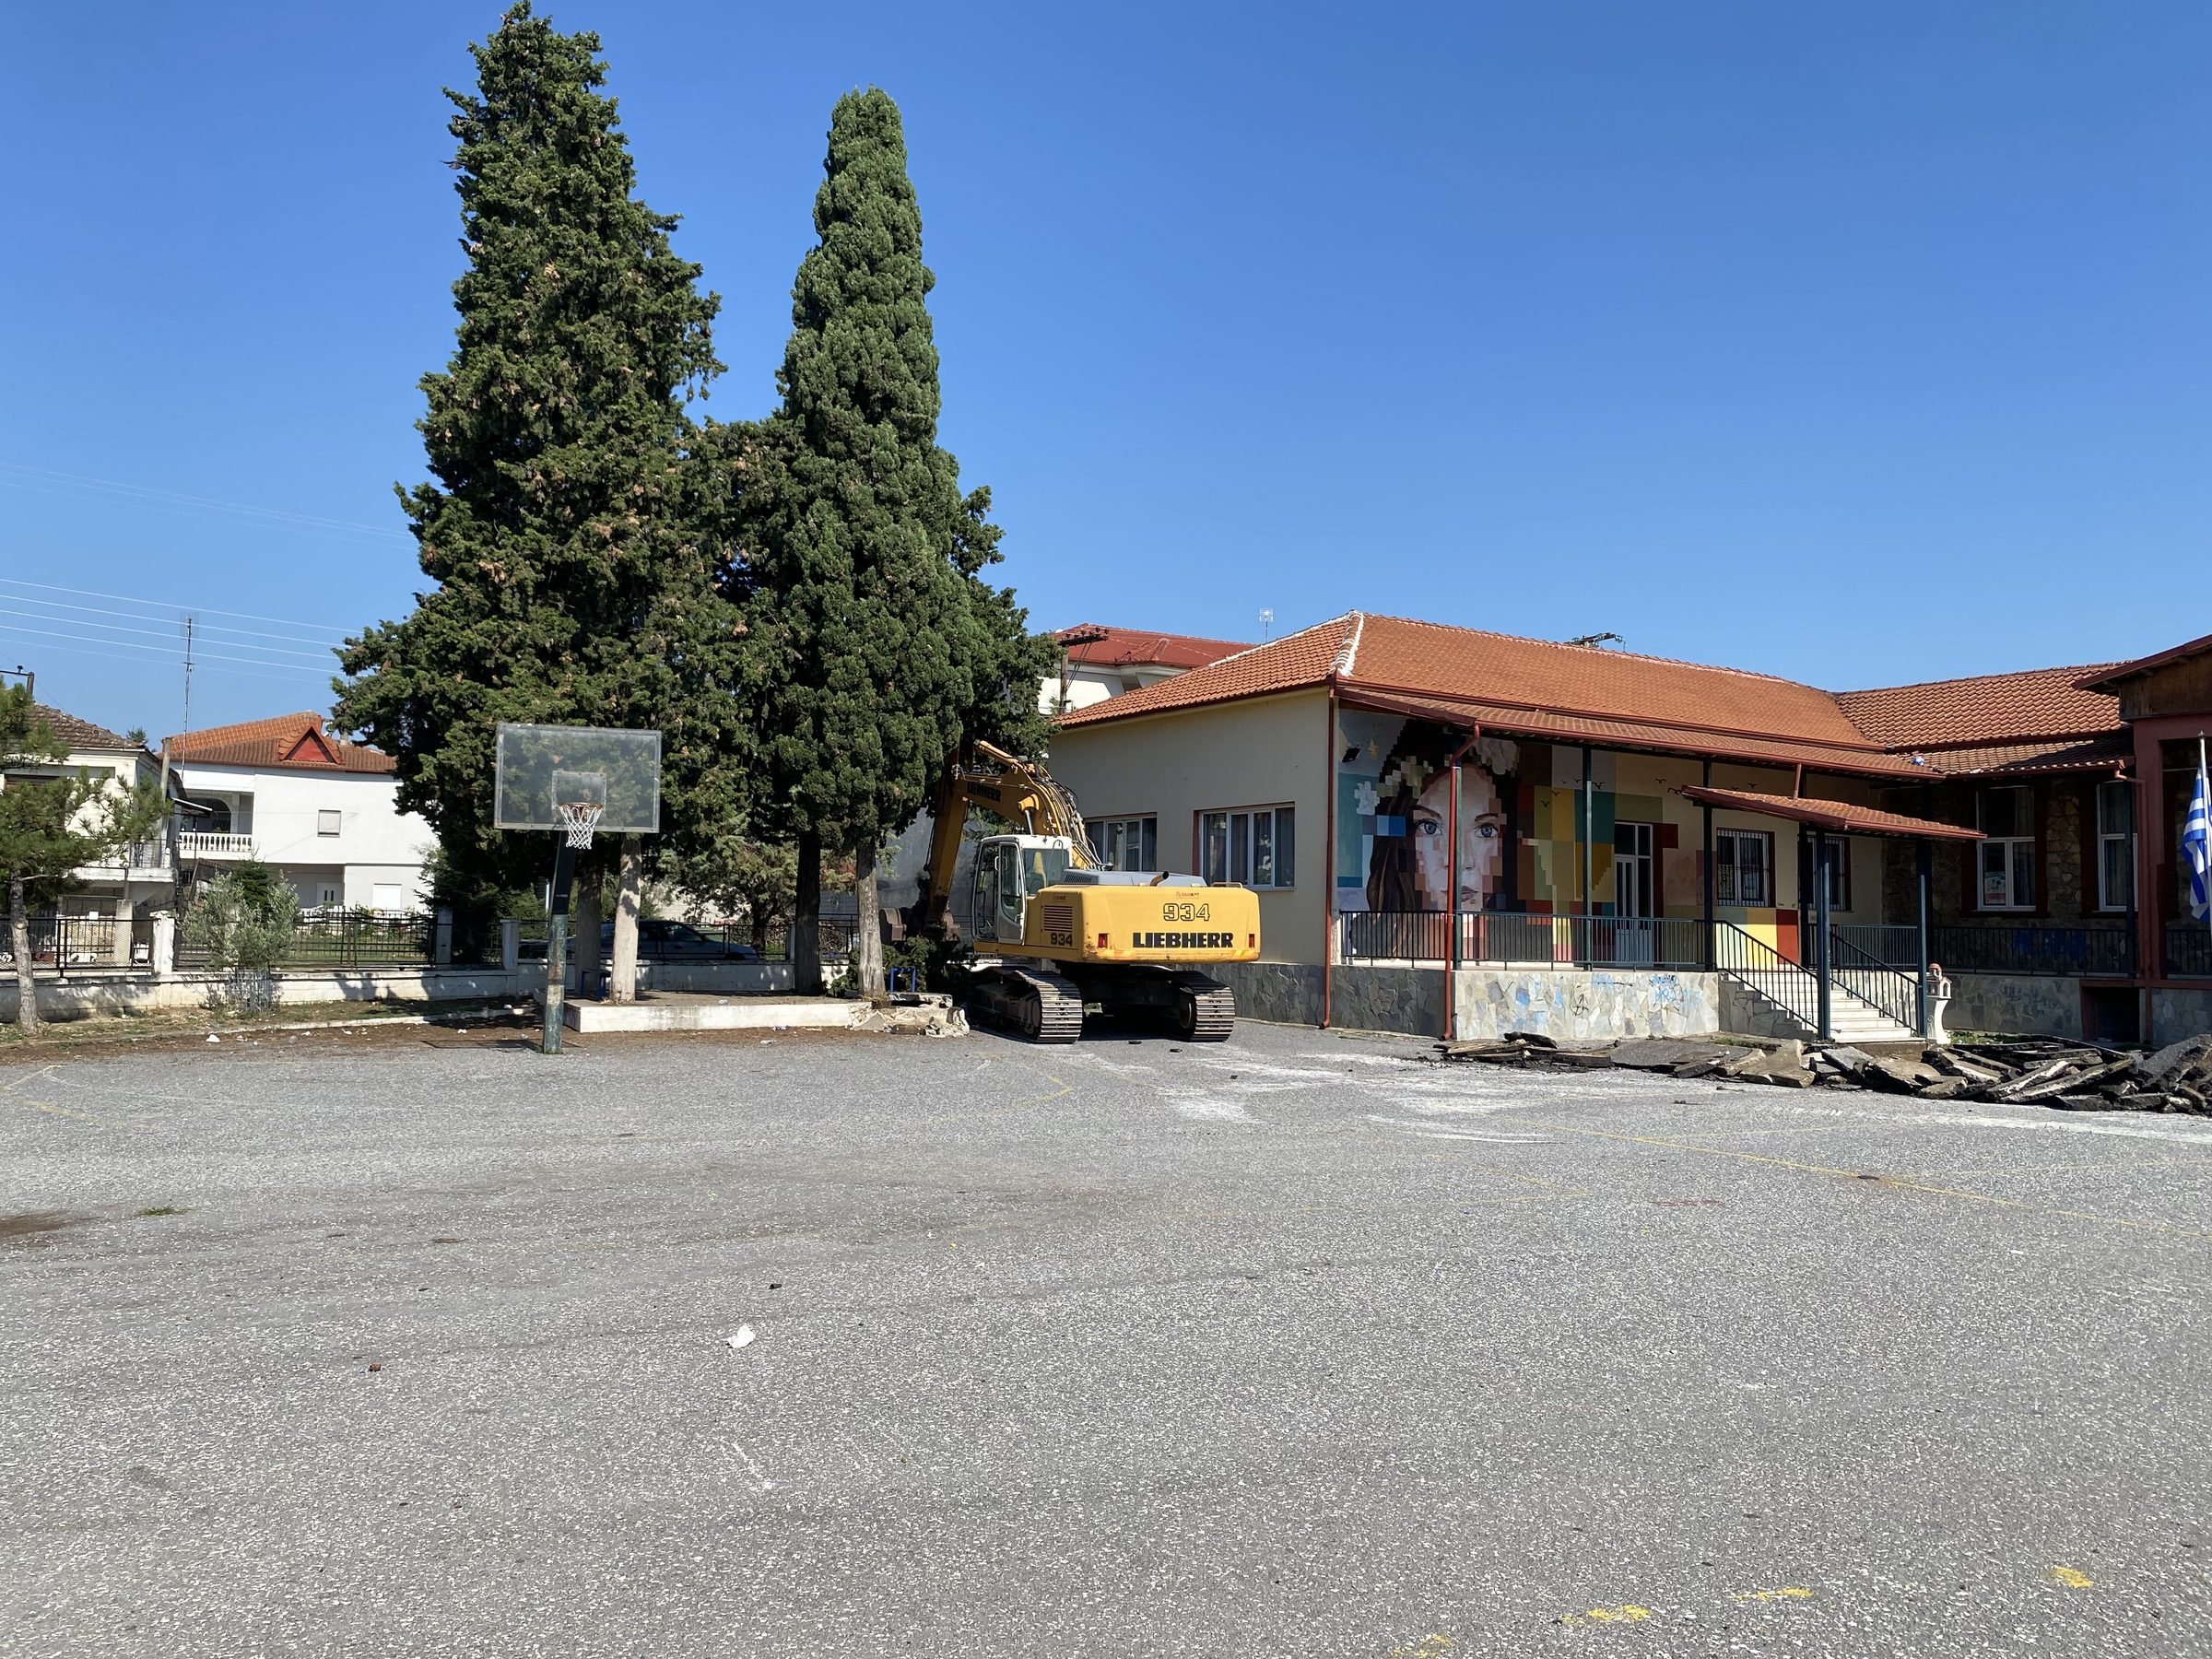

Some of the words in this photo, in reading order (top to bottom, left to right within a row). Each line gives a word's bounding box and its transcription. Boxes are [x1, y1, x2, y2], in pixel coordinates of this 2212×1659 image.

[1163, 903, 1210, 921] 934
[1051, 933, 1072, 947] 934
[1133, 933, 1233, 947] LIEBHERR
